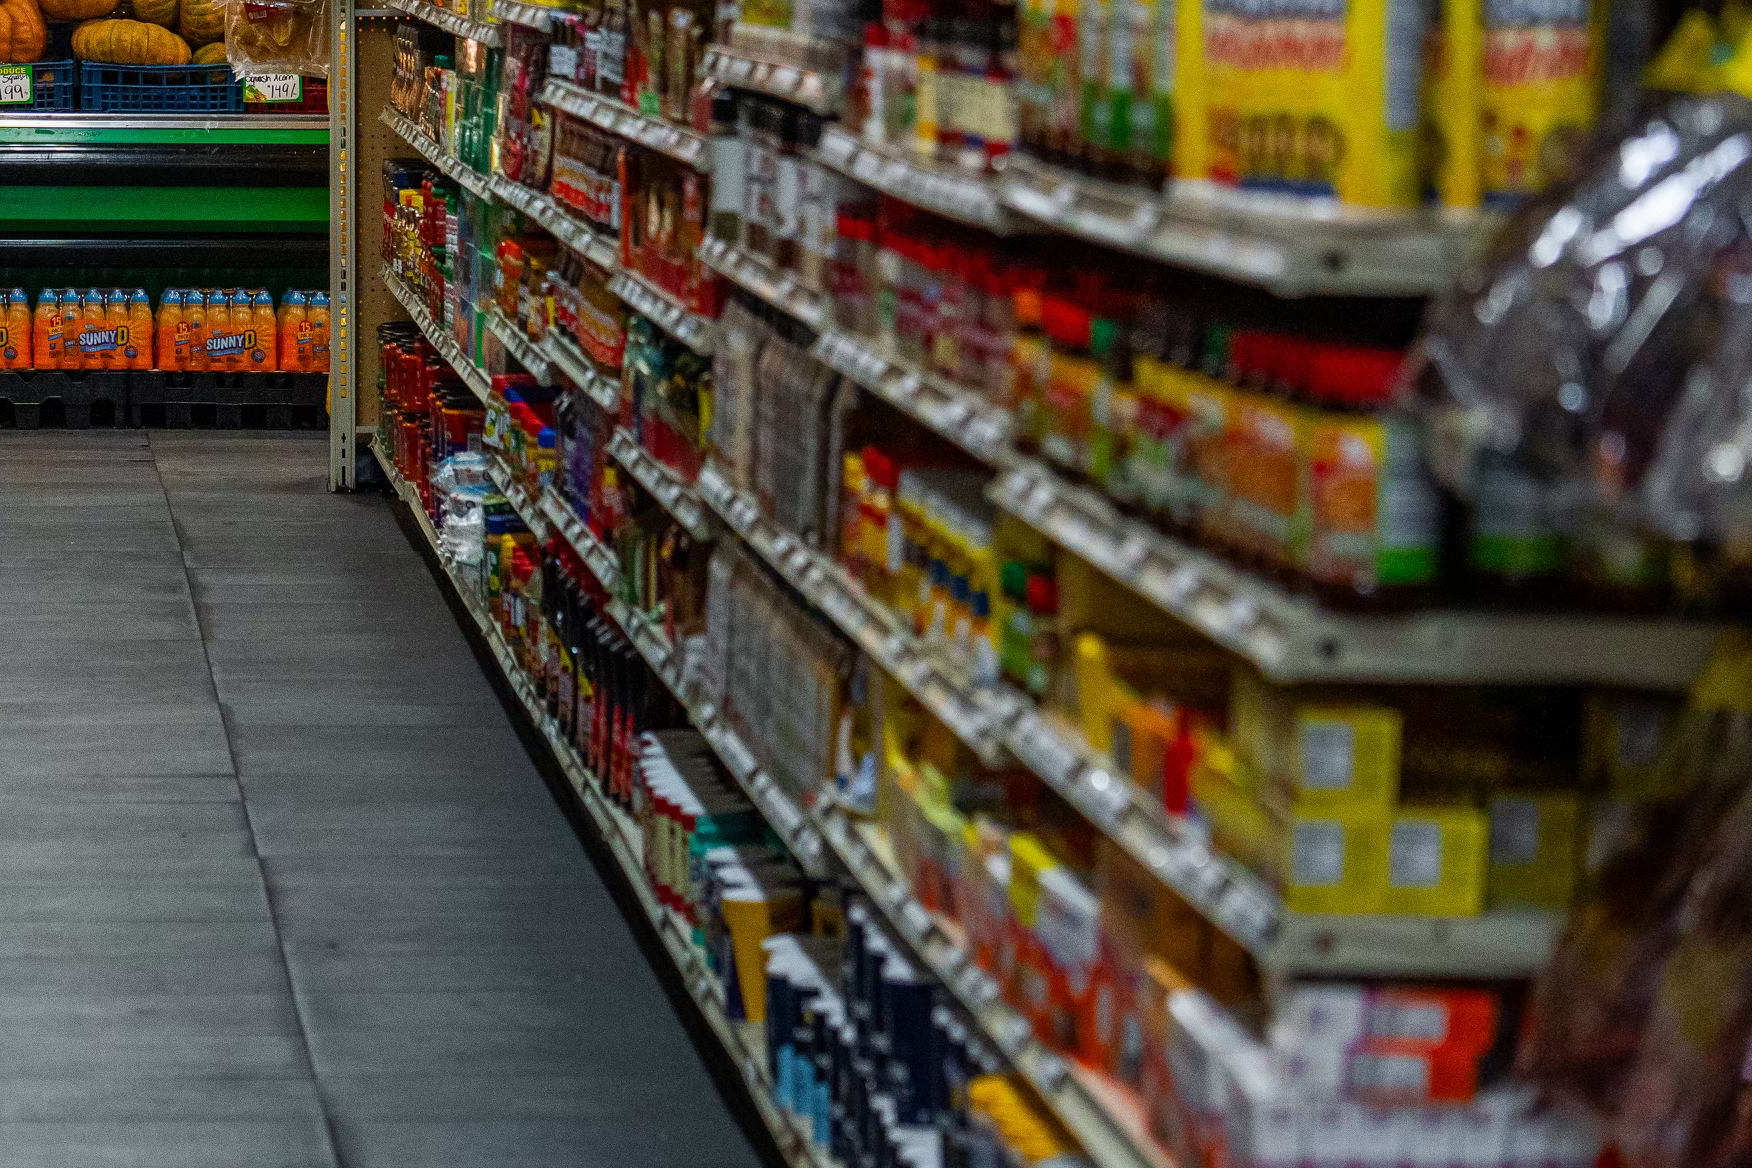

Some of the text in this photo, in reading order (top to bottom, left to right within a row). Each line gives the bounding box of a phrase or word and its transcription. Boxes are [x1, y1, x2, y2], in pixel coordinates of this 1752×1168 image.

[51, 316, 61, 327] 15
[300, 321, 311, 331] 15
[177, 322, 188, 333] 15
